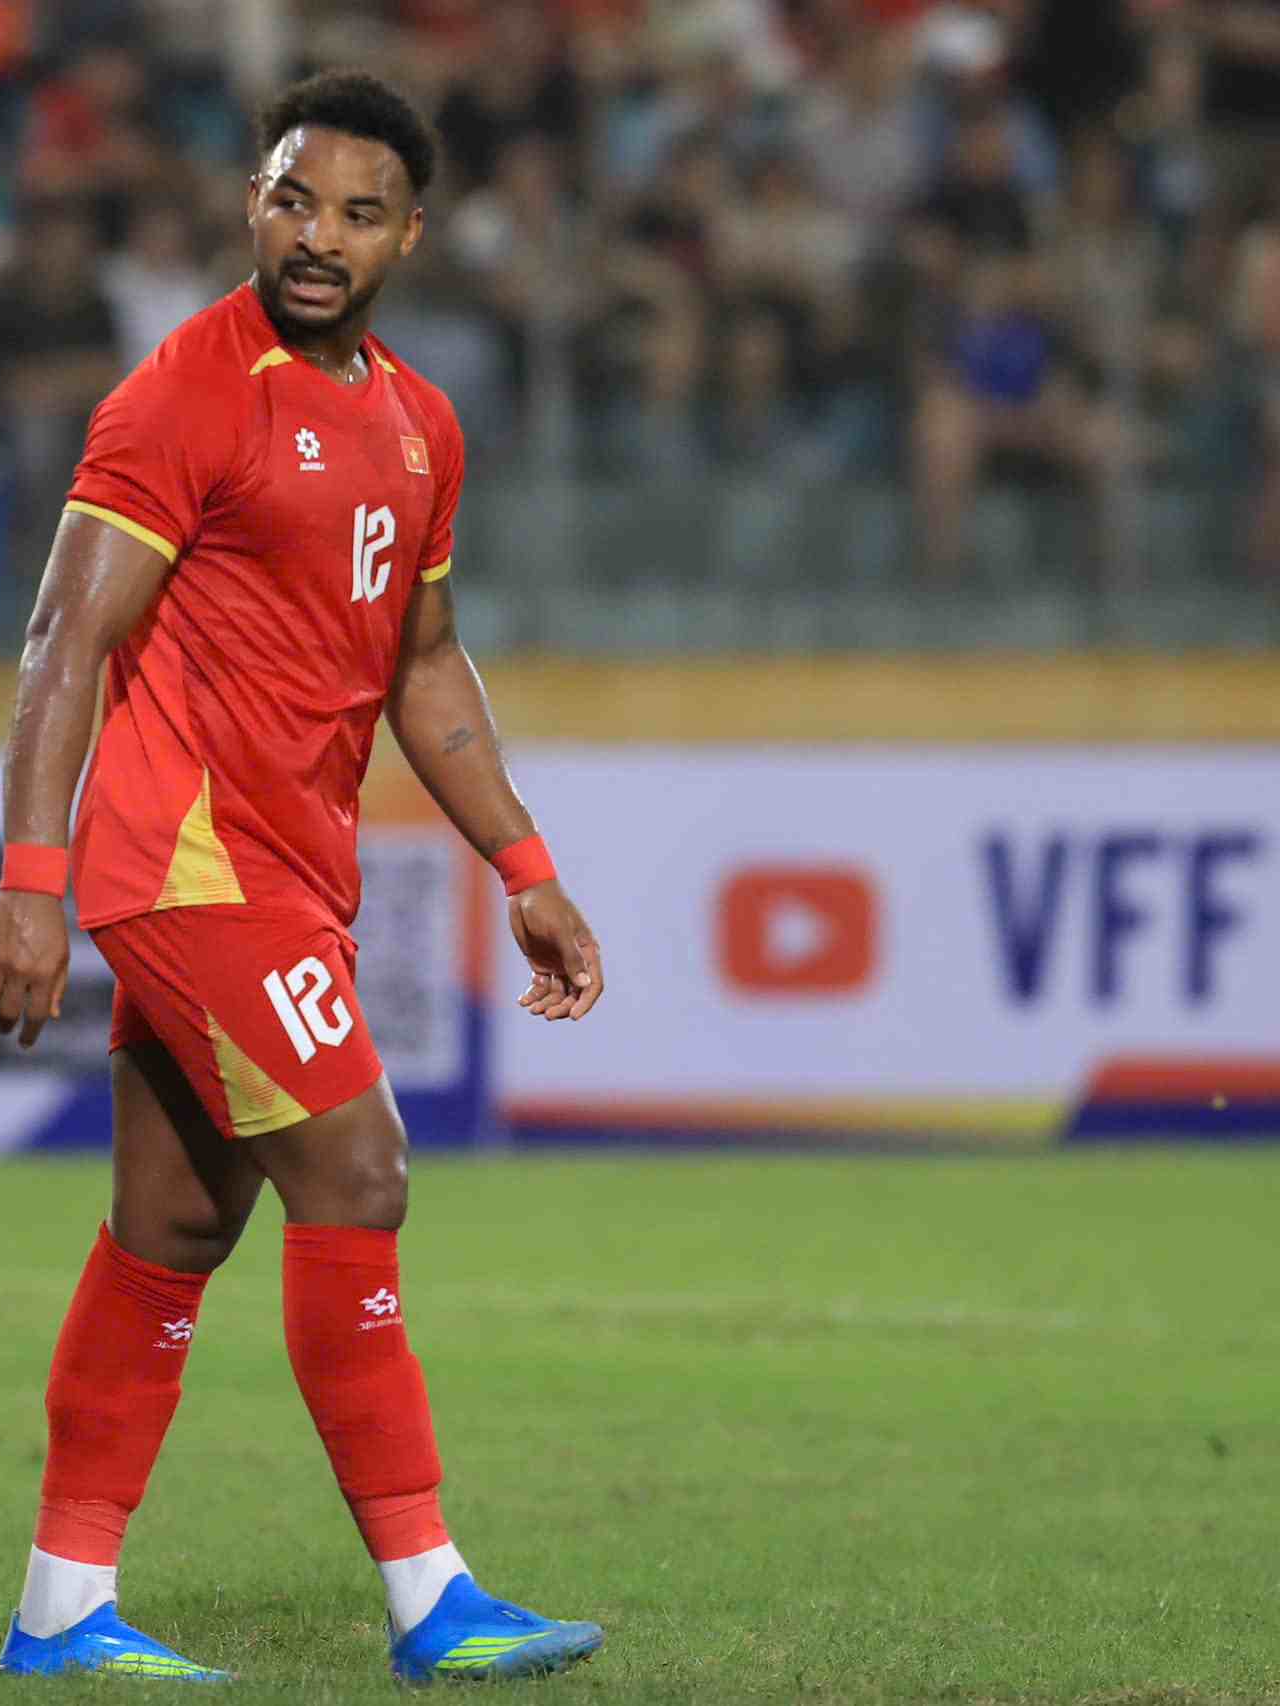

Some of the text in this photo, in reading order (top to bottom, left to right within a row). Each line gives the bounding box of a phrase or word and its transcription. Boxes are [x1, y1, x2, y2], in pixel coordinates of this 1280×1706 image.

[350, 503, 396, 604] 12
[980, 830, 1264, 1005] VFF
[262, 956, 354, 1065] 12
